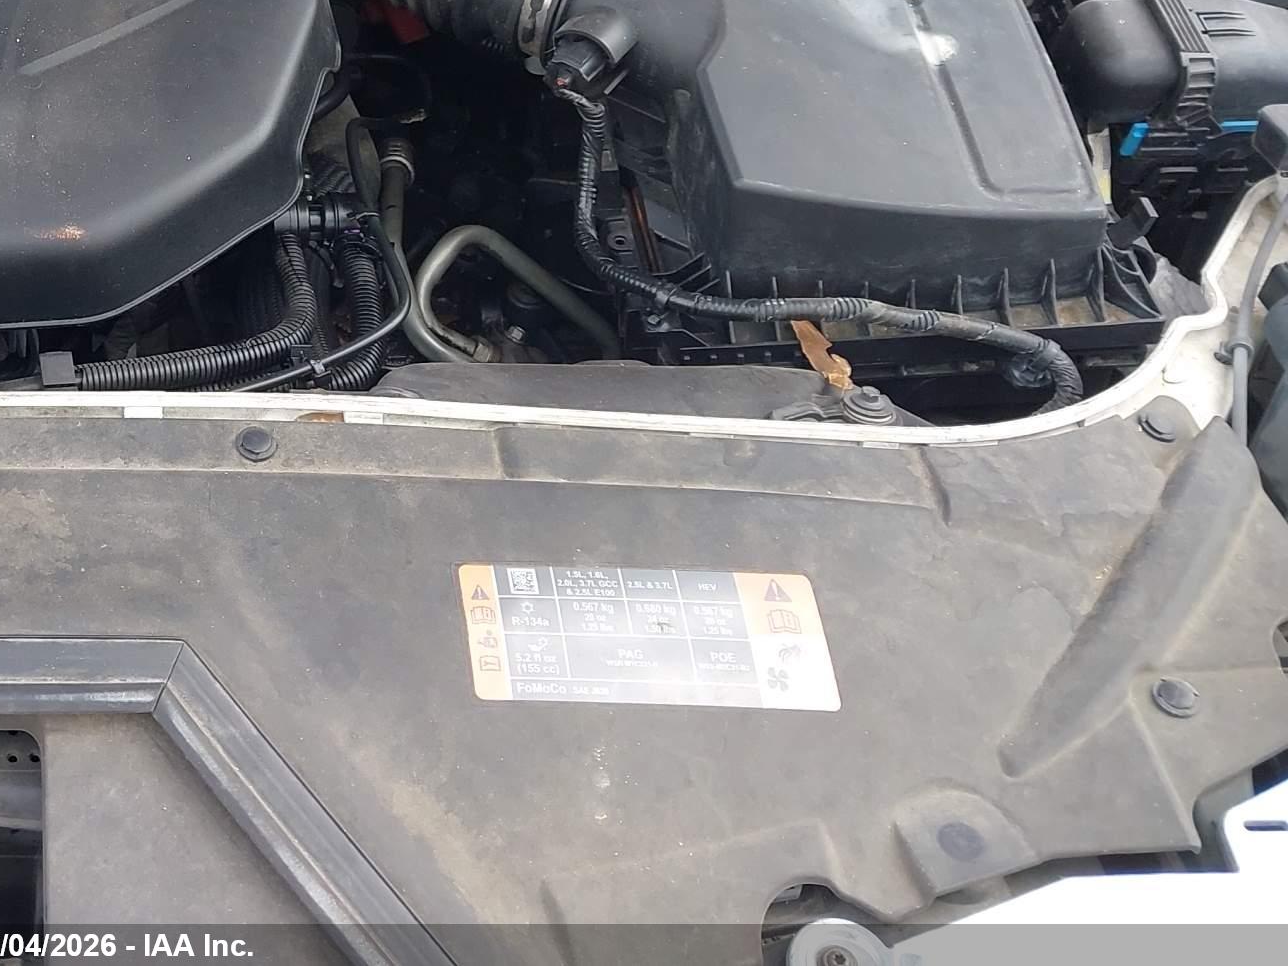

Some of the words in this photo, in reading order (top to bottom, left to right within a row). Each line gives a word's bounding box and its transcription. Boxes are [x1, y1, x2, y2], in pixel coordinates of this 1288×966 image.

[511, 616, 550, 627] R-134a
[516, 653, 532, 662] 5.2
[617, 649, 644, 660] PAG
[710, 652, 737, 663] POE
[518, 664, 540, 674] (155
[542, 665, 560, 675] cc)
[516, 682, 567, 694] FoMoCo
